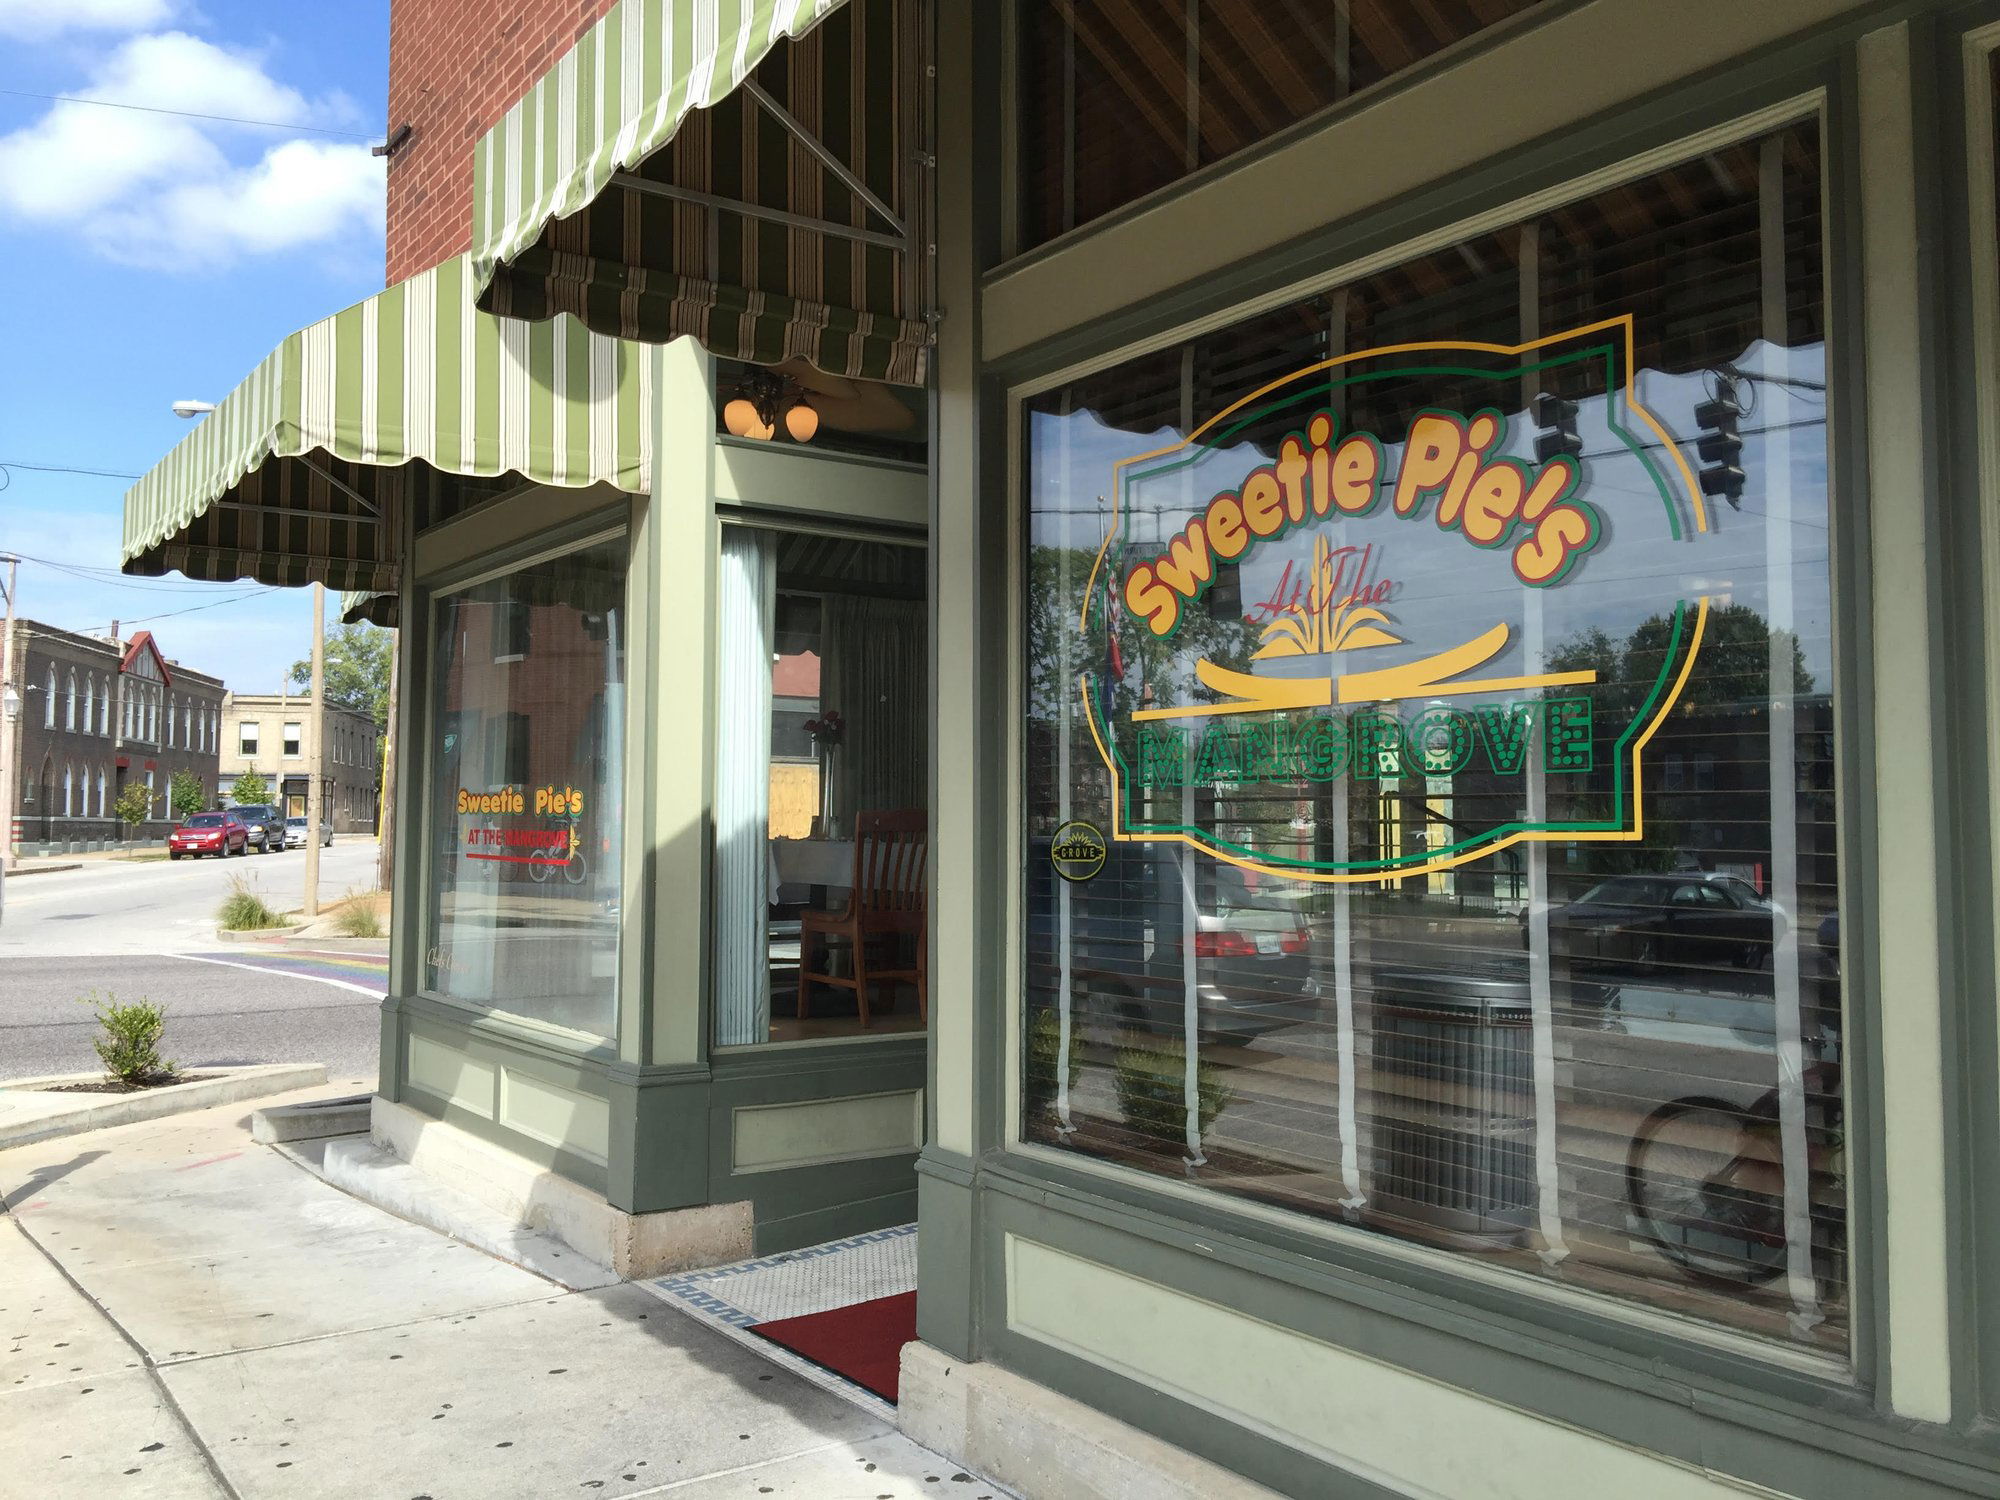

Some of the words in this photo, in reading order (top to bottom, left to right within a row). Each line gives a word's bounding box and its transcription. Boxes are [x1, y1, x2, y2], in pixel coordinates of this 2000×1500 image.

[1124, 408, 1384, 640] Sweetie
[1393, 408, 1600, 588] Pie's
[1243, 559, 1303, 625] At
[1306, 542, 1392, 616] The
[1137, 697, 1593, 790] MANGROVE
[457, 786, 525, 815] Sweetie
[534, 784, 583, 817] Pie's
[467, 829, 481, 845] AT
[482, 829, 502, 846] THE
[504, 830, 568, 849] MANGROVE
[1061, 847, 1095, 858] GROVE
